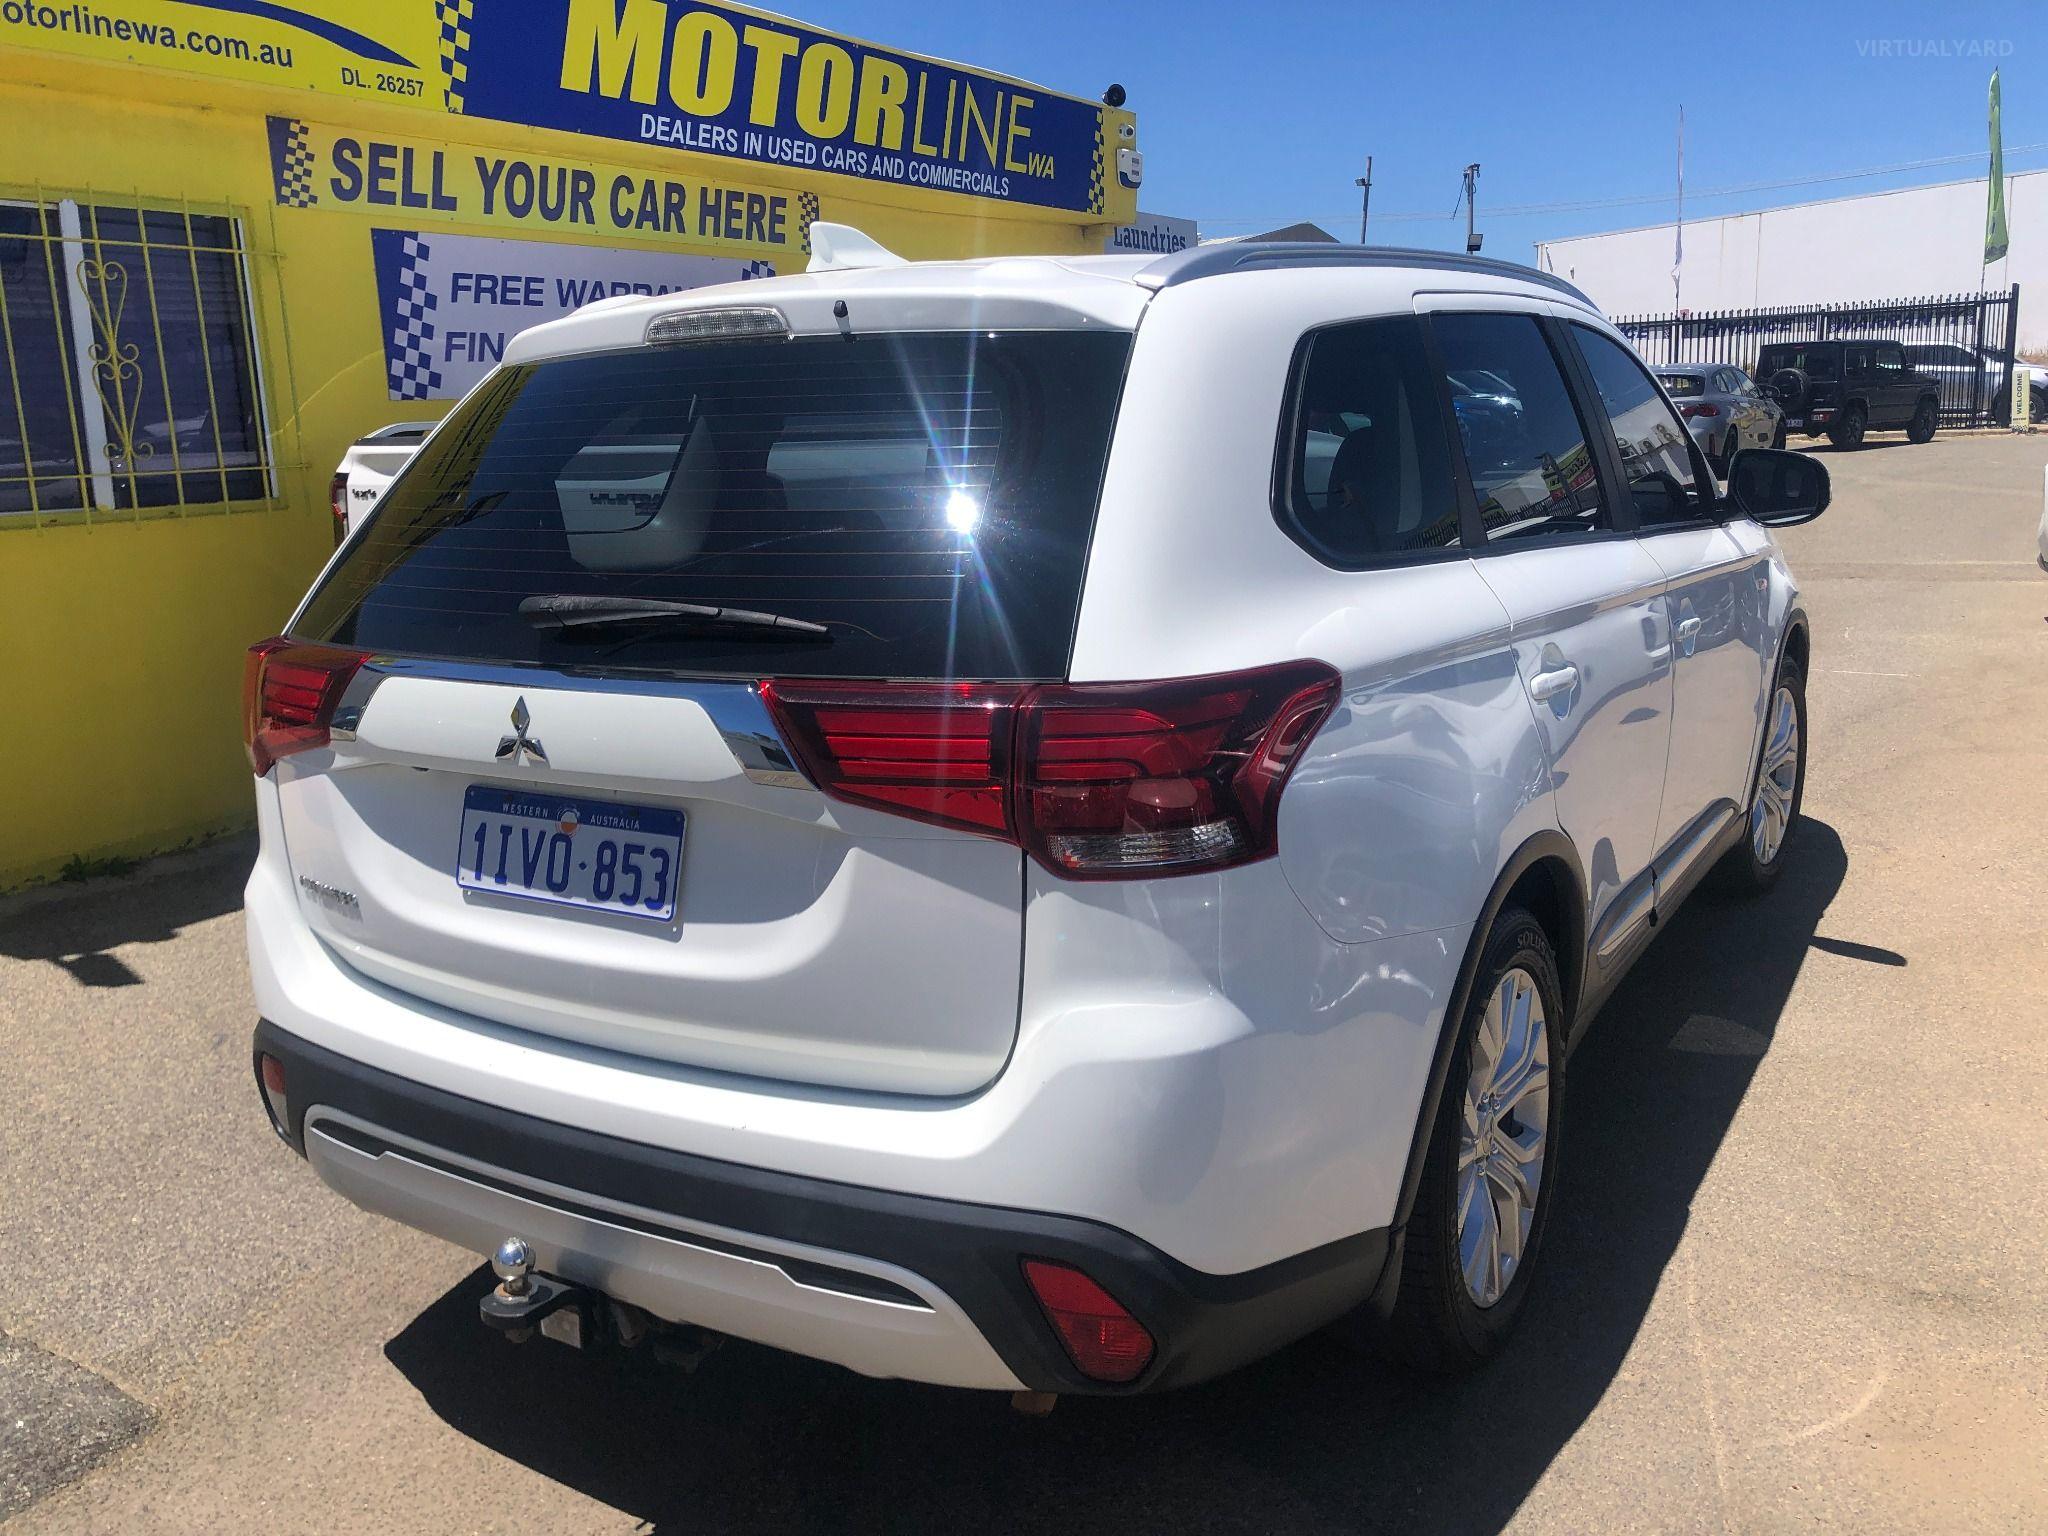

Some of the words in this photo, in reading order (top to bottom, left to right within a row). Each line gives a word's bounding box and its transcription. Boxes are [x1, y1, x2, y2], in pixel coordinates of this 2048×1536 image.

[341, 67, 371, 88] DL.
[376, 73, 424, 97] 26257
[640, 113, 738, 153] DEALERS
[743, 131, 762, 157] IN
[768, 135, 817, 165] USED
[821, 145, 867, 174] CARS
[870, 154, 904, 180] AND
[908, 160, 1009, 196] COMMERCIALS
[1027, 151, 1055, 180] WA
[330, 137, 457, 212] SELL
[474, 156, 596, 225] YOUR
[609, 174, 686, 234] CAR
[698, 186, 787, 245] HERE
[1113, 225, 1187, 254] Laundries
[451, 272, 544, 307] FREE
[445, 331, 518, 363] FIN
[502, 803, 549, 818] WESTERN
[590, 814, 641, 831] AUSTRALIA
